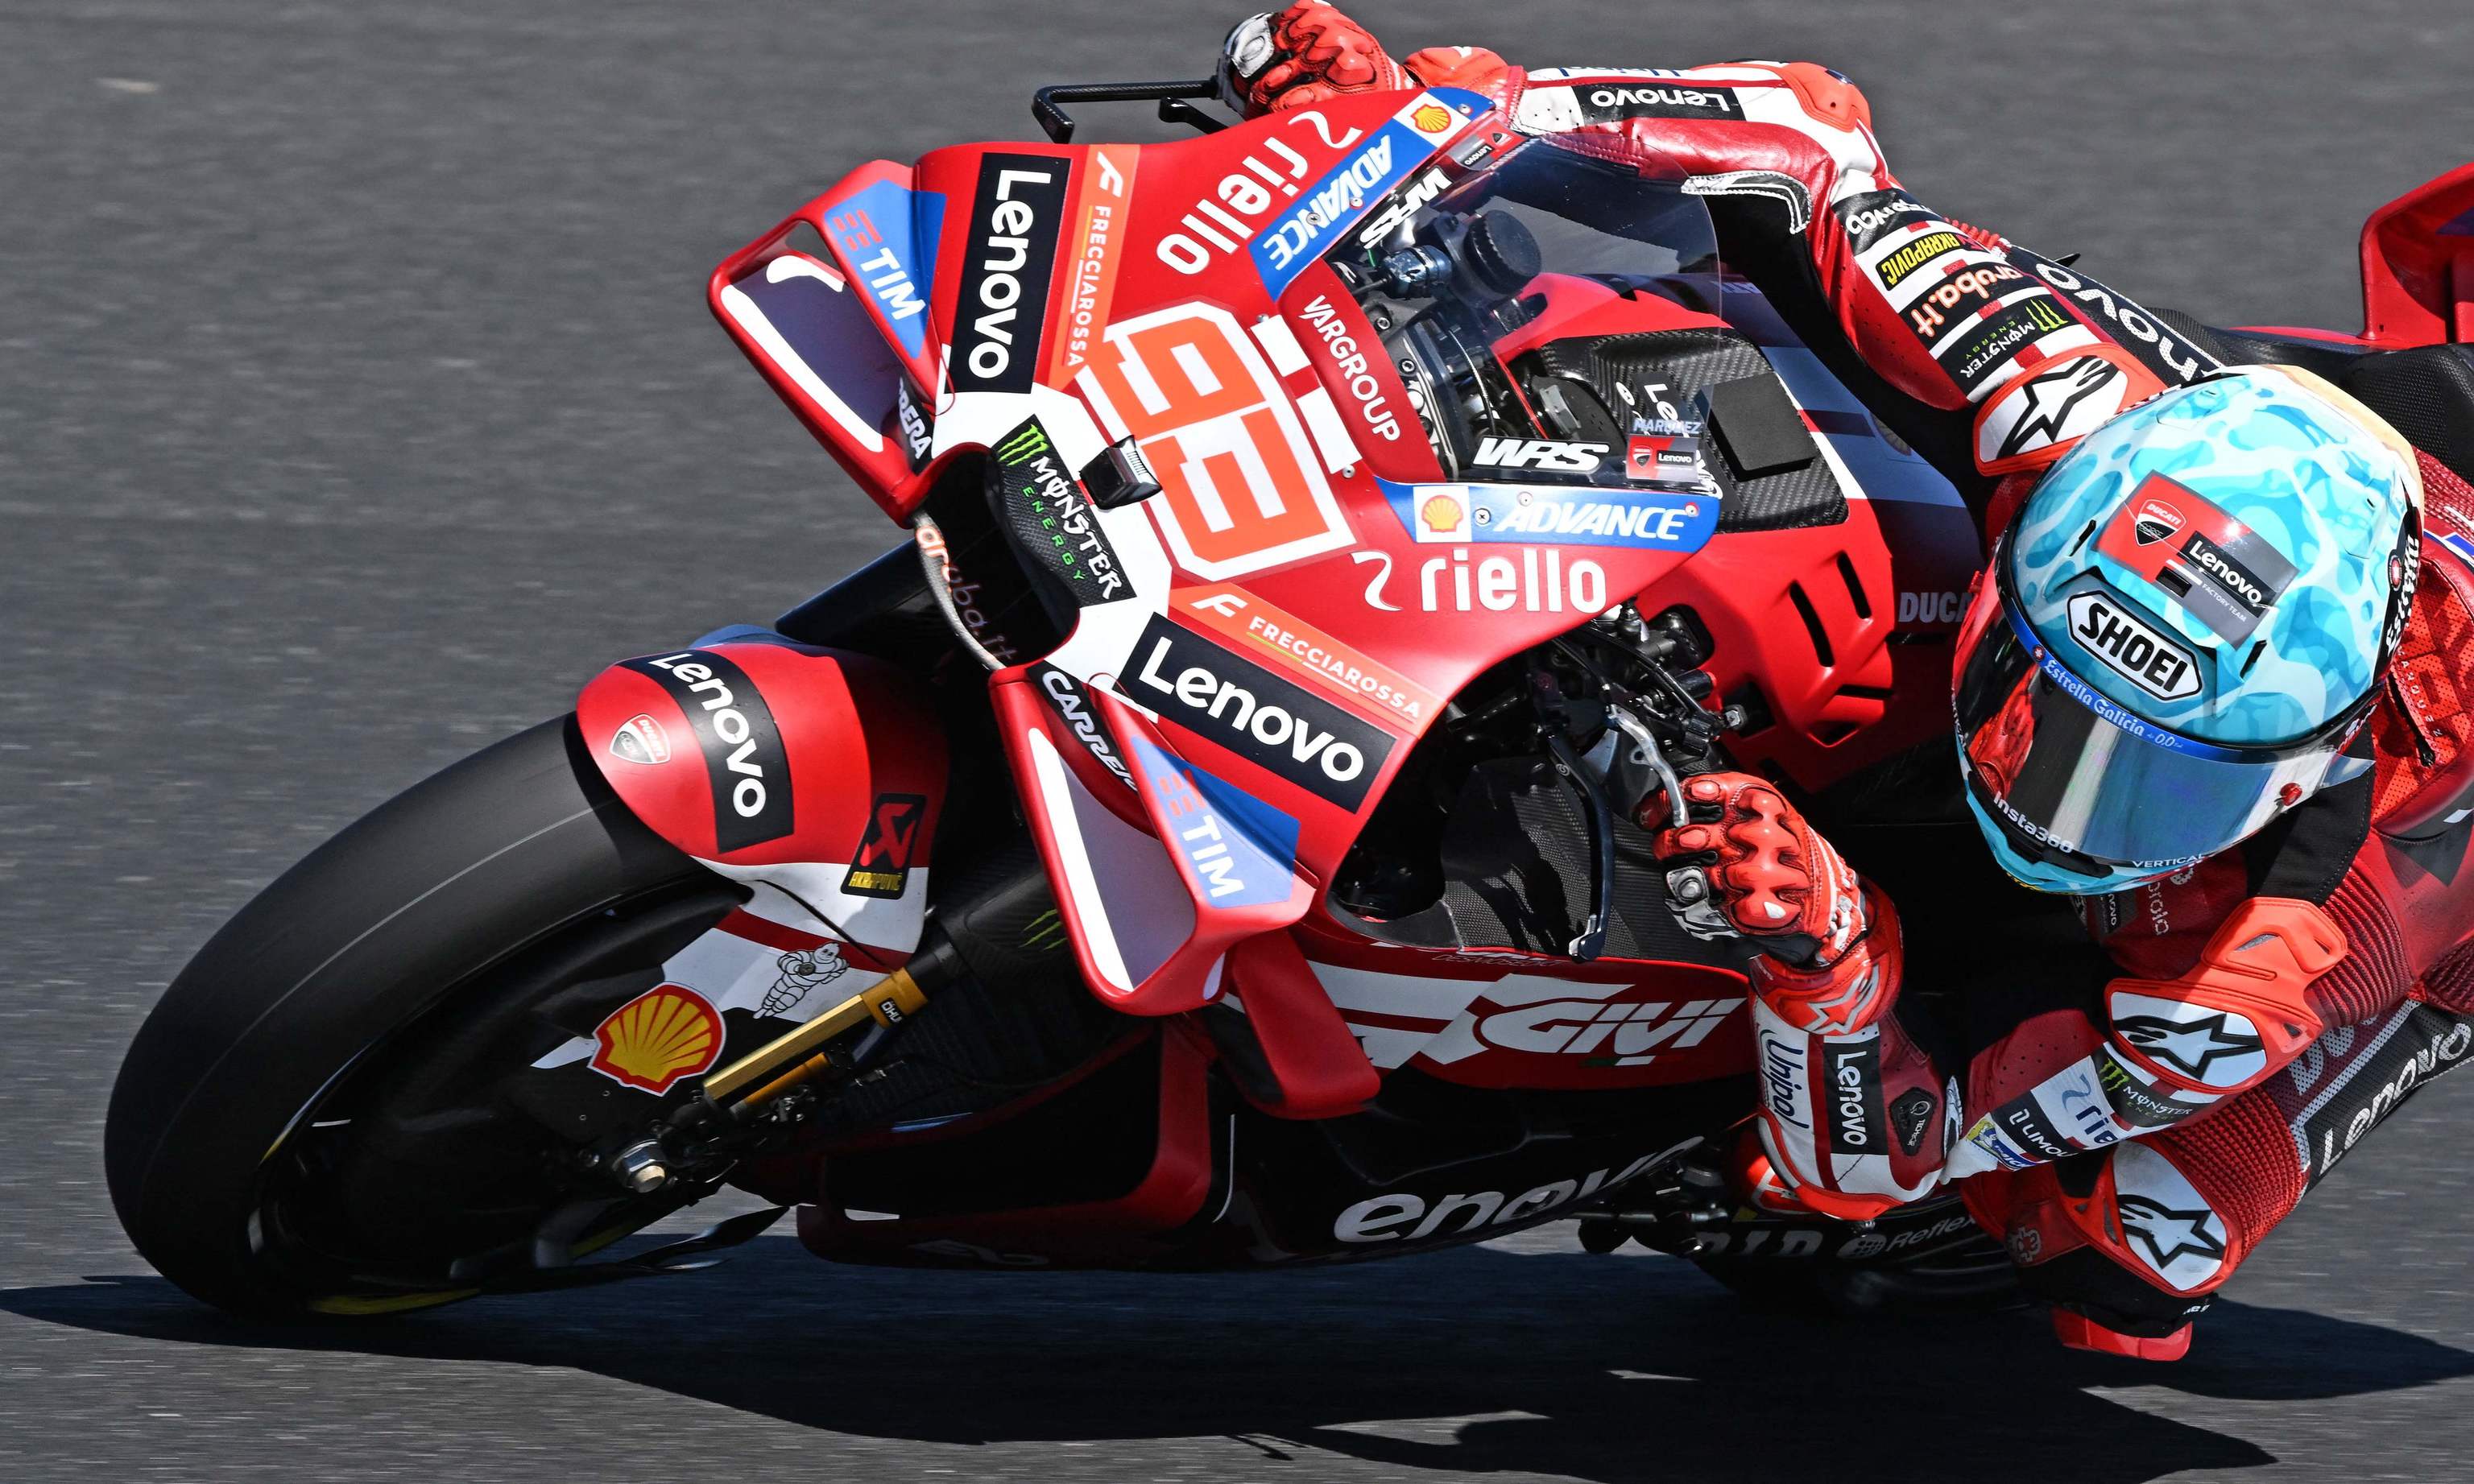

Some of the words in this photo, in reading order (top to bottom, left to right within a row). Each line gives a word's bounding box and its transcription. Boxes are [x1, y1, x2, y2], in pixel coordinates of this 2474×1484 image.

[1591, 89, 1730, 112] Lenovo
[1463, 145, 1492, 166] Lenovo
[1156, 137, 1308, 275] riello
[1263, 134, 1392, 271] ADVANCE
[1359, 167, 1453, 249] WRS
[860, 247, 926, 320] TIM
[969, 169, 1052, 379] Lenovo
[1067, 205, 1111, 367] FRECCIAROSSA
[1911, 264, 2024, 338] aruba.it
[1298, 295, 1401, 442] VARGROUP
[1084, 310, 1337, 570] 93
[1471, 436, 1610, 471] WRS
[1657, 453, 1693, 464] Lenovo
[1022, 486, 1086, 581] ENERGY
[1492, 500, 1691, 541] ADVANCE
[2145, 502, 2182, 526] DUCATI
[1420, 549, 1607, 613] riello
[2189, 539, 2262, 604] Lenovo
[2201, 584, 2229, 608] FACTORY
[2228, 604, 2248, 622] TEAM
[1248, 616, 1421, 720] FRECCIAROSSA
[2078, 602, 2189, 692] SHOEI
[647, 653, 767, 818] Lenovo
[1138, 636, 1364, 782] Lenovo
[2044, 659, 2092, 706] Estrella
[2093, 698, 2145, 737] Galicia
[1182, 815, 1245, 899] TIM
[1993, 790, 2076, 854] Insta360
[2133, 853, 2205, 868] VERTICAL
[1766, 1039, 1810, 1129] Unipol
[1836, 1050, 1868, 1147] Lenovo
[2319, 1023, 2472, 1176] Lenovo
